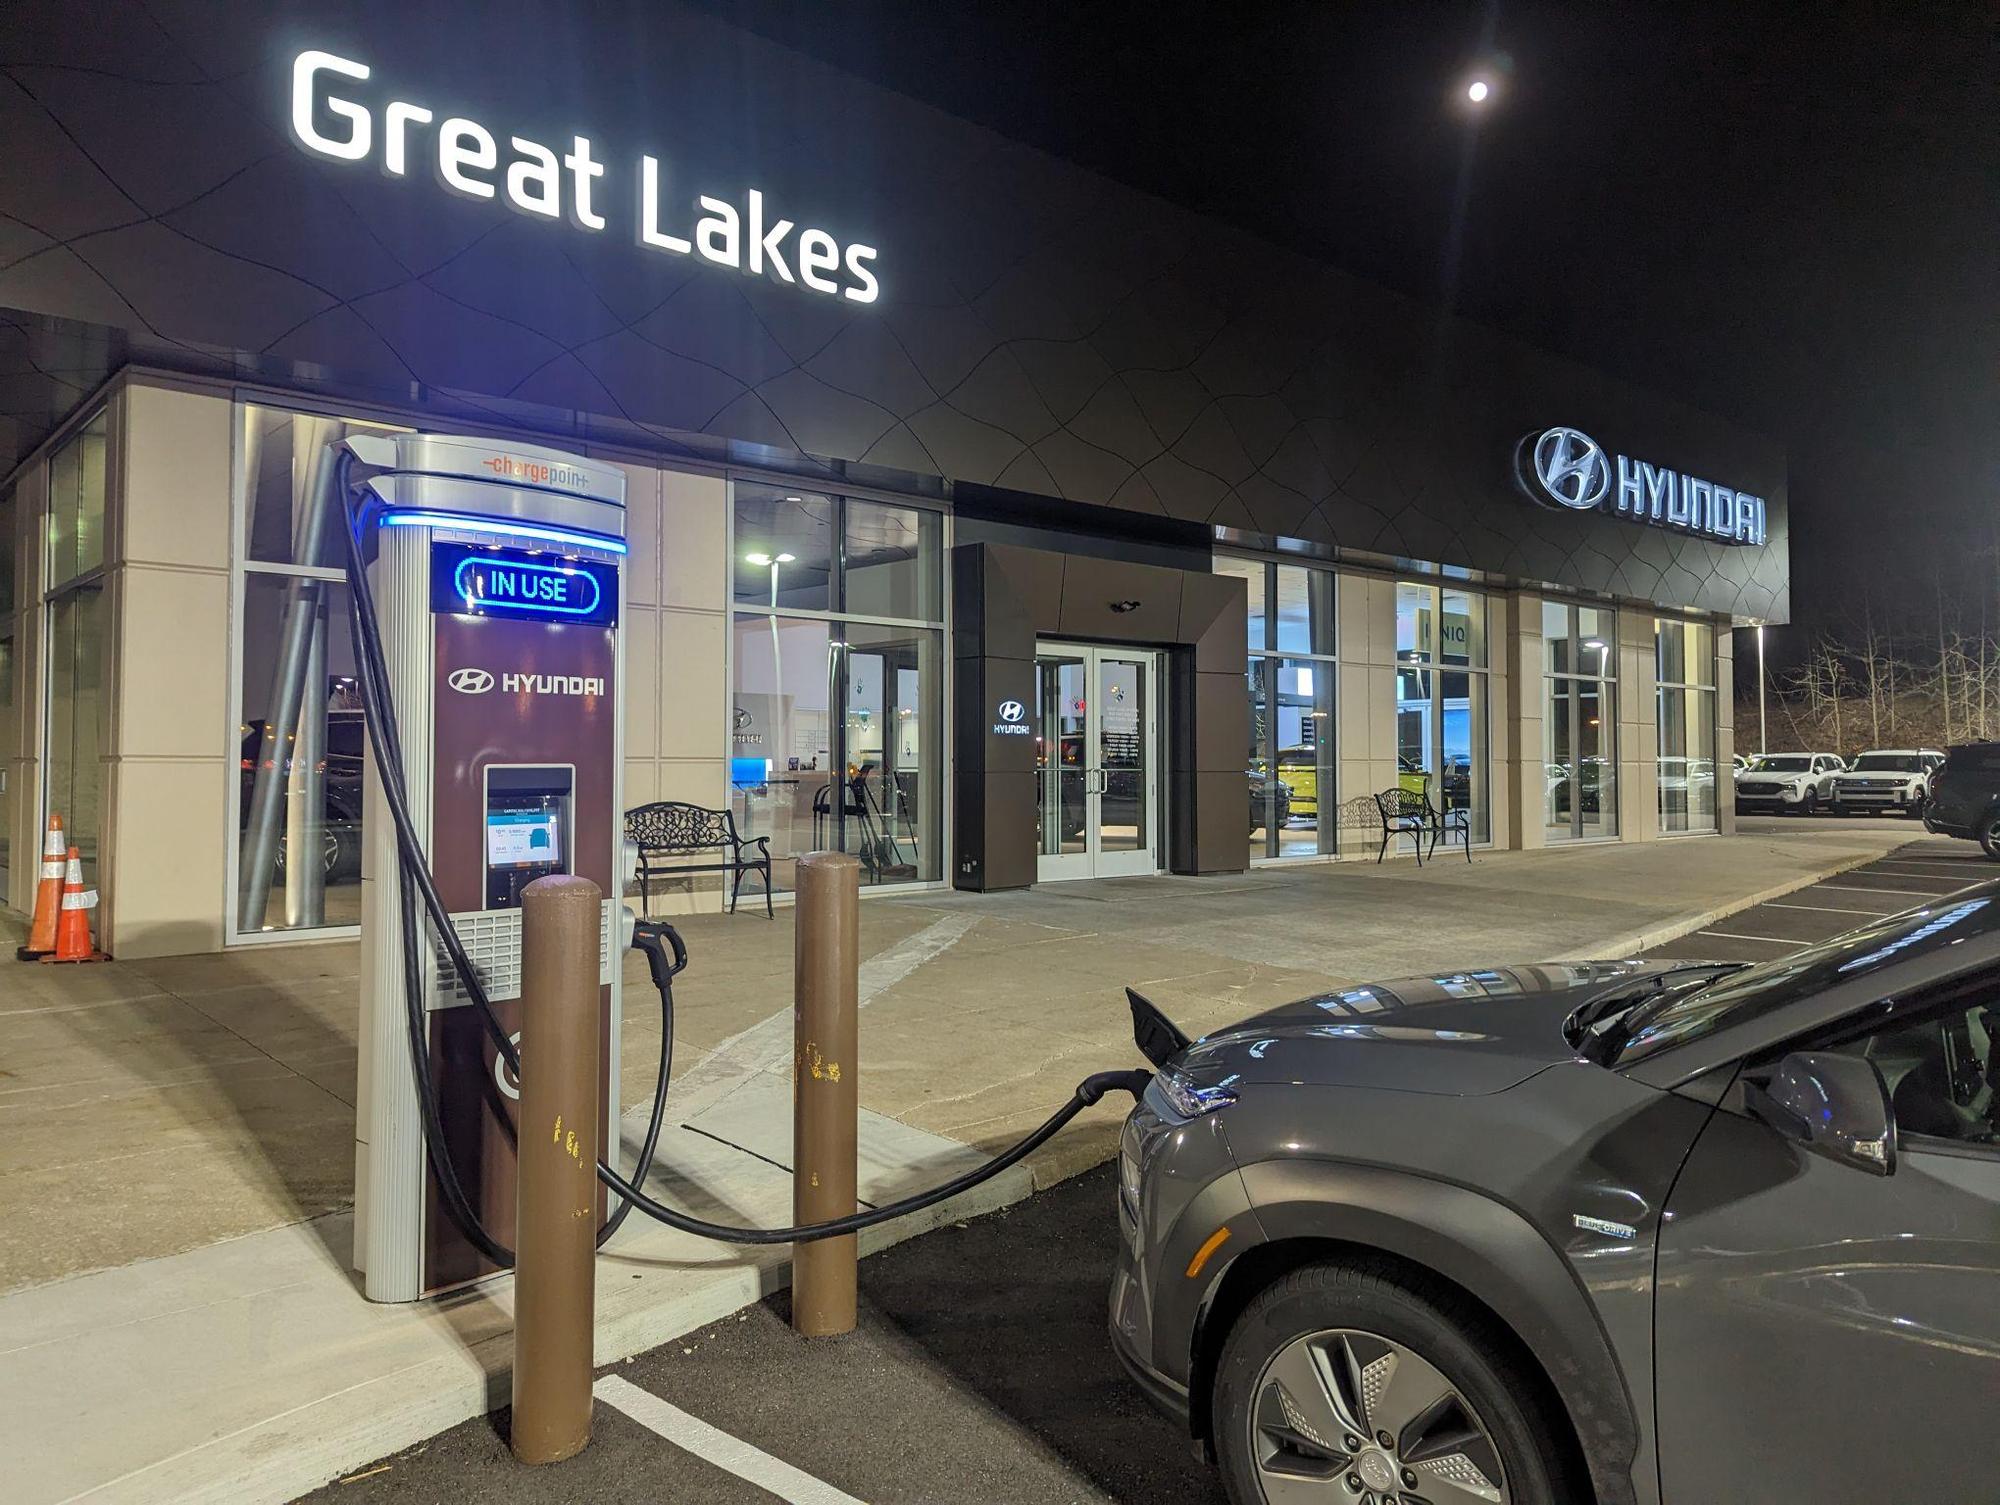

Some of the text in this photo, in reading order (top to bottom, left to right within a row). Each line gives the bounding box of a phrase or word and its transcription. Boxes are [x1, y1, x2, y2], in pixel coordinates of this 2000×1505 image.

[292, 50, 881, 303] Great Lakes
[1616, 454, 1768, 545] HYUNDAI
[491, 570, 567, 602] IN USE
[1425, 623, 1466, 643] INIQ
[502, 673, 604, 696] HYUNDAI
[993, 724, 1030, 734] HYUNDAI
